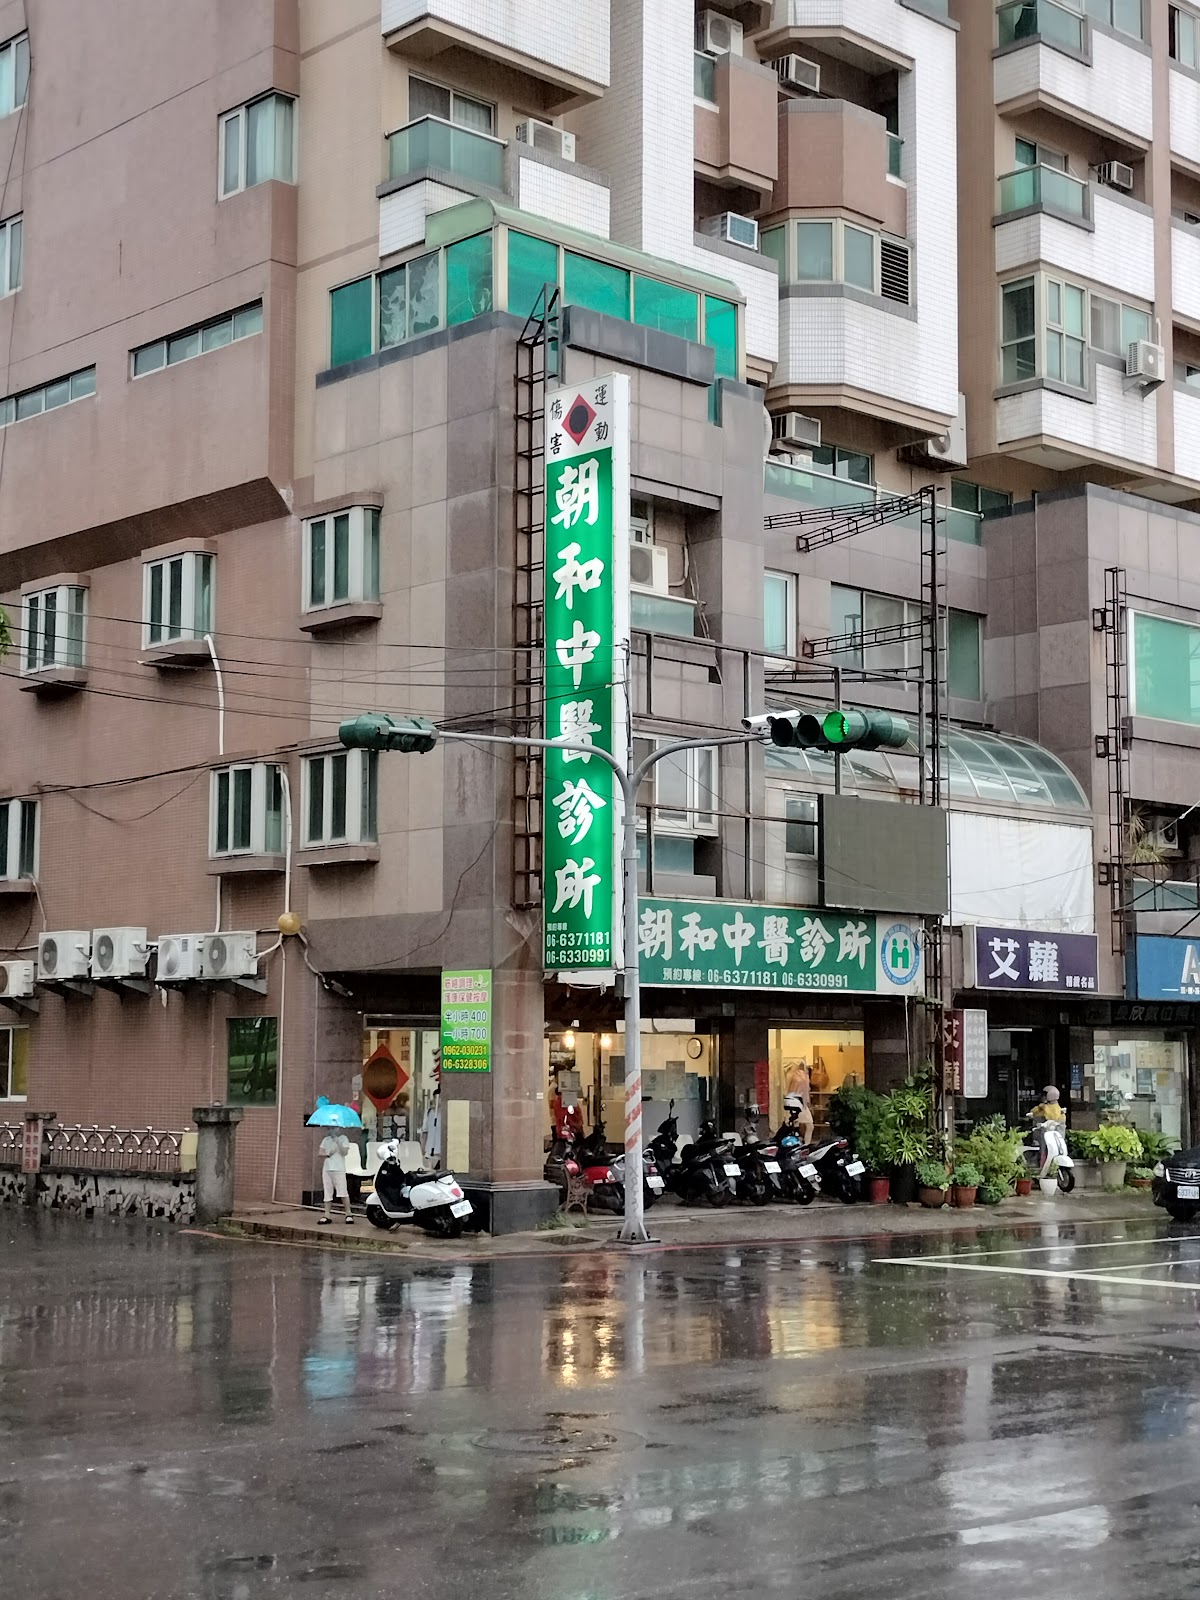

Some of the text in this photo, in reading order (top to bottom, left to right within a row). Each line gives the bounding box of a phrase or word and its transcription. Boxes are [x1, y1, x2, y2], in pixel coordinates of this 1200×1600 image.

[594, 383, 609, 443] 運動
[549, 398, 563, 456] 傷害
[550, 458, 608, 920] 朝和中醫診所
[546, 931, 610, 947] 06-6371181
[637, 907, 872, 970] 朝和中醫診所
[546, 948, 610, 964] 06-6330991
[988, 937, 1059, 983] 艾蘿
[707, 968, 778, 985] 06-6371181
[781, 971, 848, 988] 06-6330991
[444, 1010, 487, 1024] 半小時 400
[444, 1027, 487, 1041] 一小時 700
[443, 1045, 487, 1056] 0962-030231
[443, 1058, 487, 1070] 06-6328306
